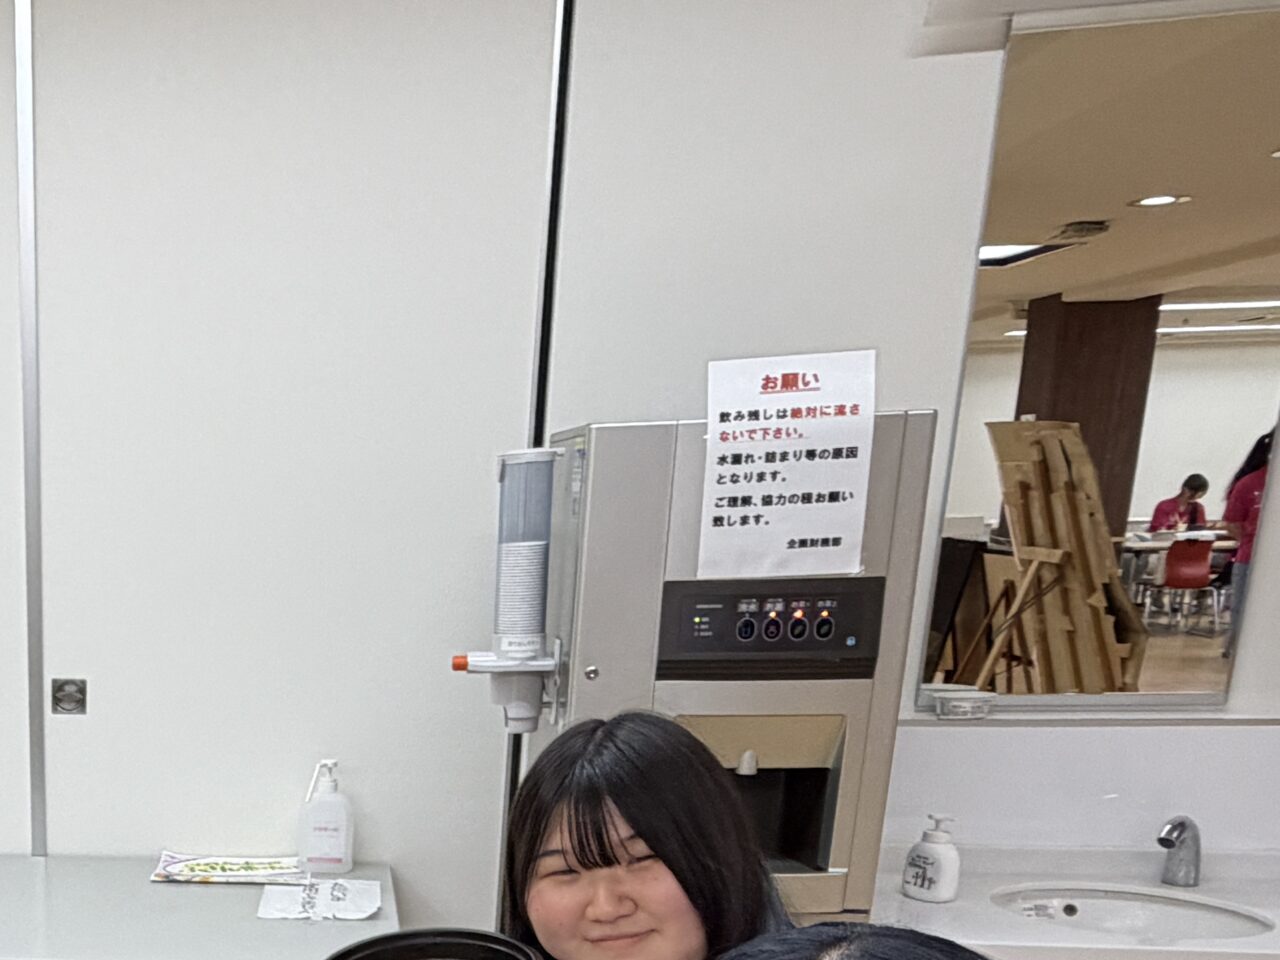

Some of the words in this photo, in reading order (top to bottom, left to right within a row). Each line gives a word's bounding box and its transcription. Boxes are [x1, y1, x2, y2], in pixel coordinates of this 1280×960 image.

[761, 372, 820, 391] お願い
[719, 426, 804, 443] ないで下さい。
[716, 470, 787, 485] となります。
[712, 514, 770, 528] 致します。
